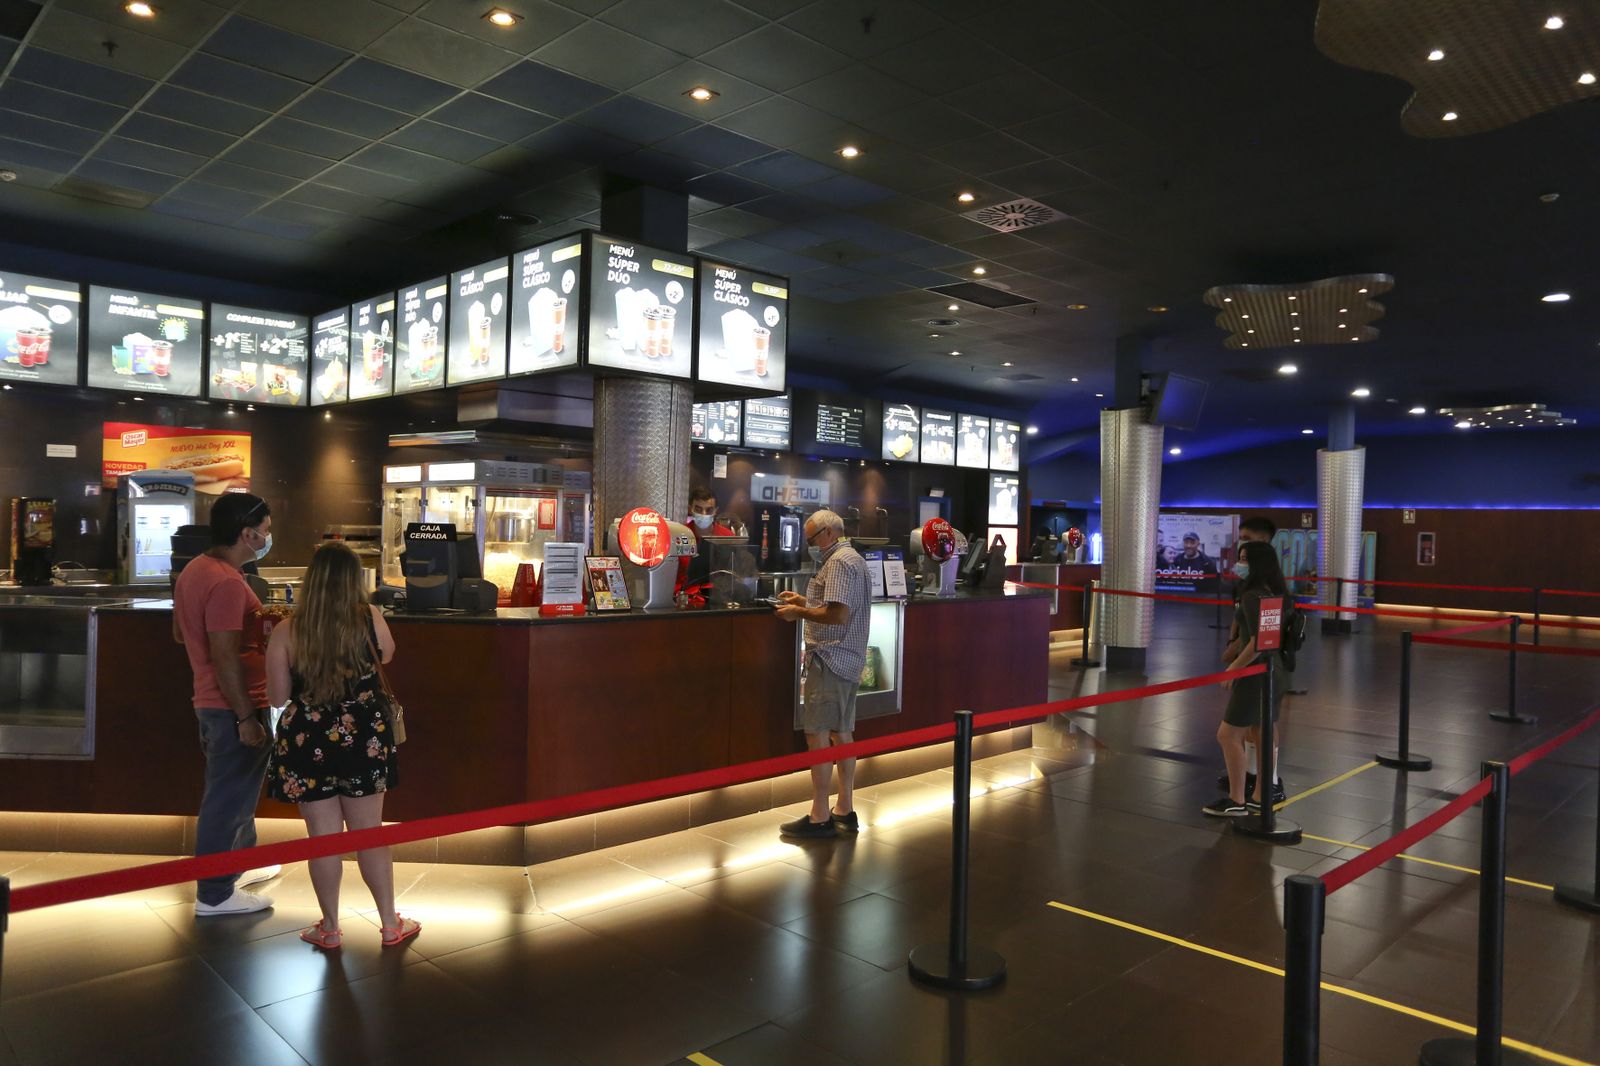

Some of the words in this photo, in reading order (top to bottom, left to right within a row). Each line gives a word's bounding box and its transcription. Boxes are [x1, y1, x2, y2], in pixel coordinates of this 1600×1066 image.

[609, 244, 634, 258] MENÚ
[523, 261, 544, 276] SÚPER
[608, 256, 640, 273] SÚPER
[523, 271, 551, 288] CLÁSICO
[607, 270, 631, 285] DÚO
[715, 268, 737, 280] MENÚ
[460, 280, 484, 297] CLÁSICO
[714, 278, 742, 294] SÚPER
[714, 290, 750, 307] CLÁSICO
[124, 438, 145, 446] Mayer
[125, 432, 144, 440] Oscar
[170, 443, 194, 453] NUEVO
[208, 443, 222, 452] Dog
[222, 440, 236, 448] XXL
[105, 462, 144, 470] NOVEDAD
[410, 532, 447, 540] CERRADA
[420, 525, 441, 533] CAJA
